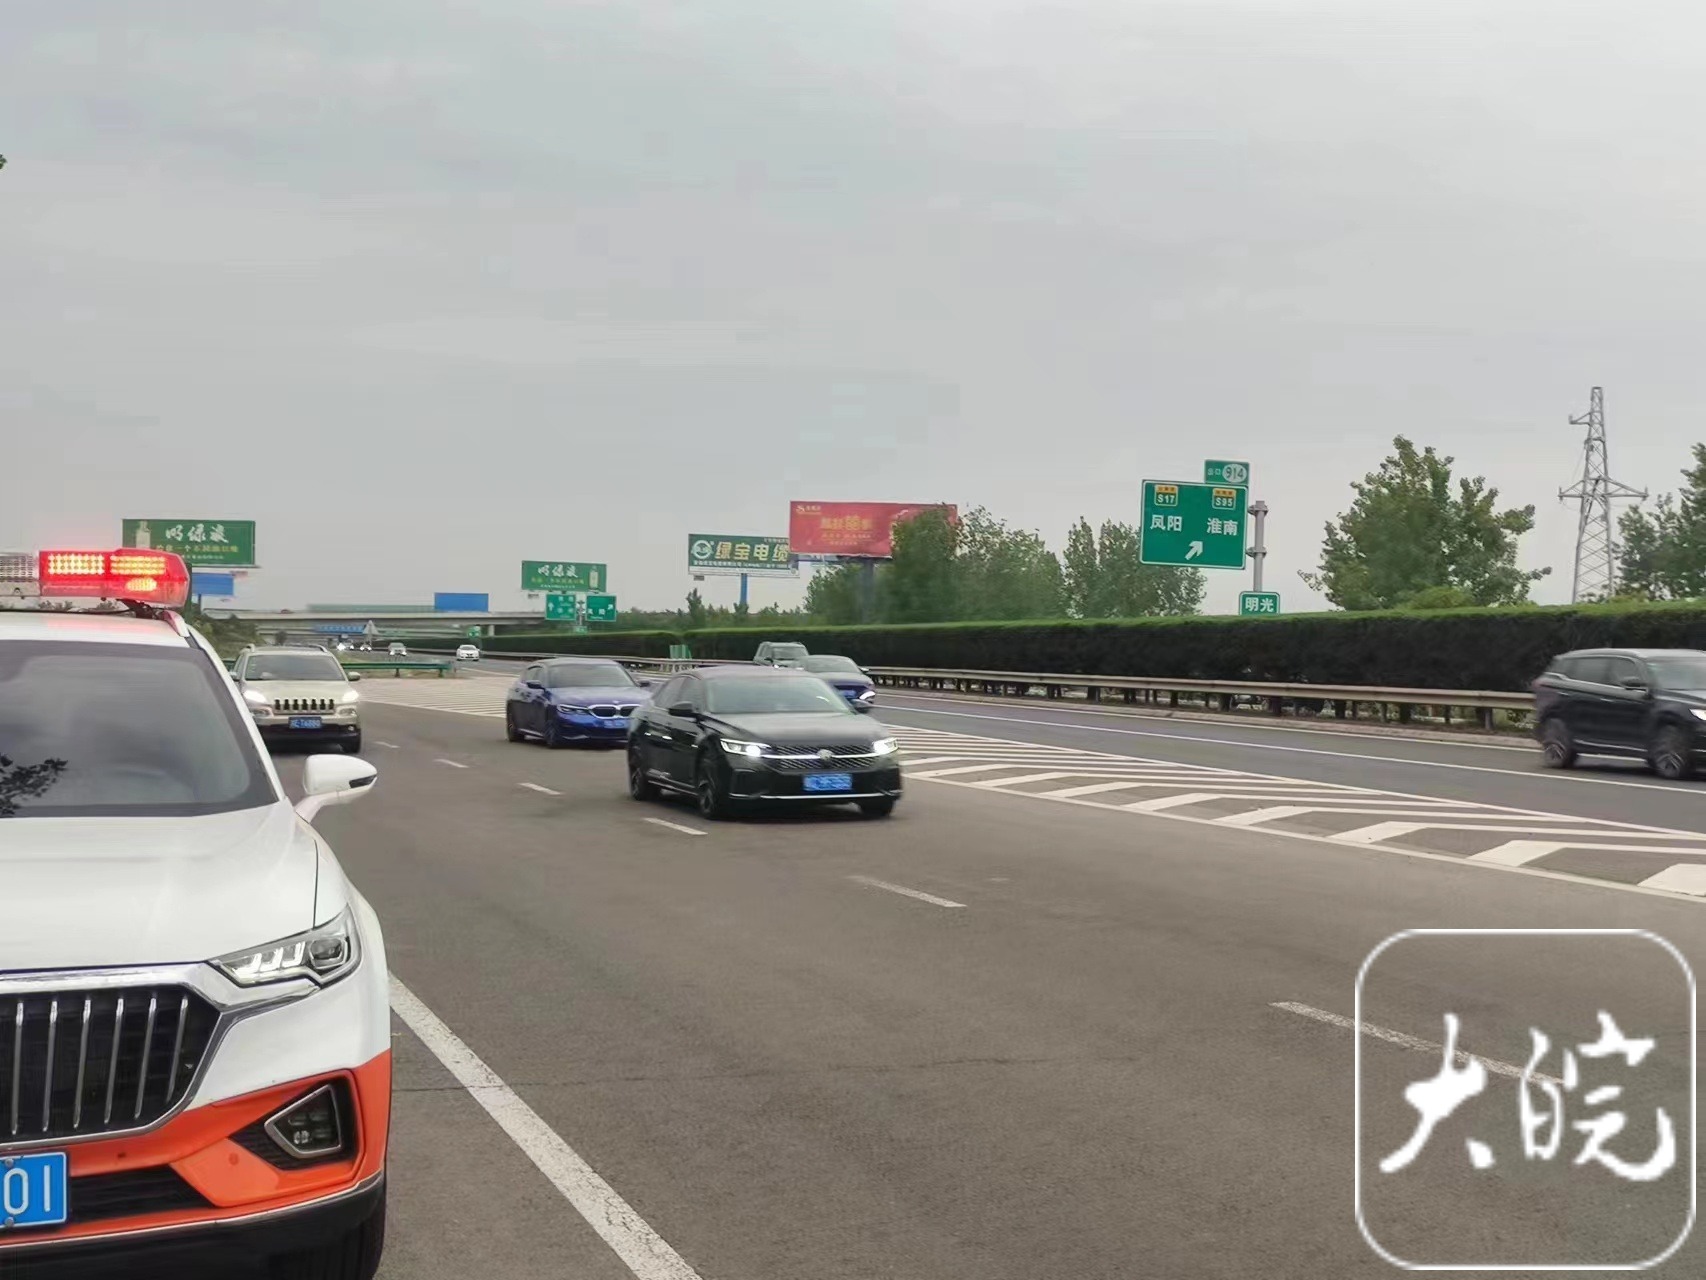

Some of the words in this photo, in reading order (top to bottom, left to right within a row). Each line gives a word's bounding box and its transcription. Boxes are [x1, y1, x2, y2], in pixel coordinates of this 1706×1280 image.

[1226, 466, 1244, 478] 914
[1157, 494, 1175, 504] S17
[1215, 497, 1233, 507] S95
[1150, 514, 1182, 532] 凤阳
[1206, 517, 1238, 536] 淮南
[714, 541, 789, 562] 绿宝电缆
[1245, 596, 1274, 612] 明光
